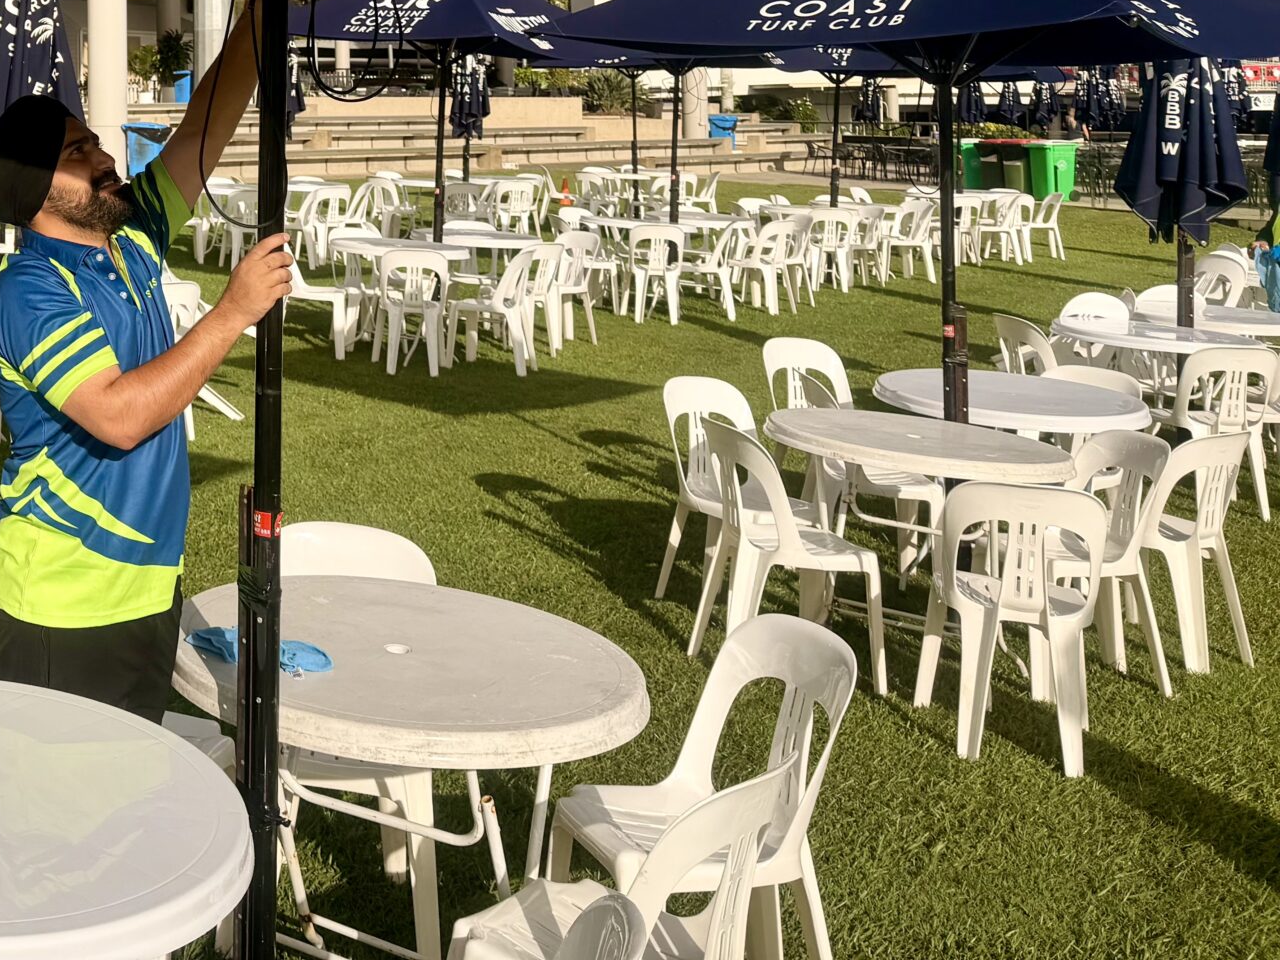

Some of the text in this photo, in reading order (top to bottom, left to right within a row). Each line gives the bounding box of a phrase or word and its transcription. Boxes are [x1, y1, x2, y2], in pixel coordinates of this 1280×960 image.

[746, 14, 906, 31] TURF CLUB
[343, 25, 375, 33] TURF
